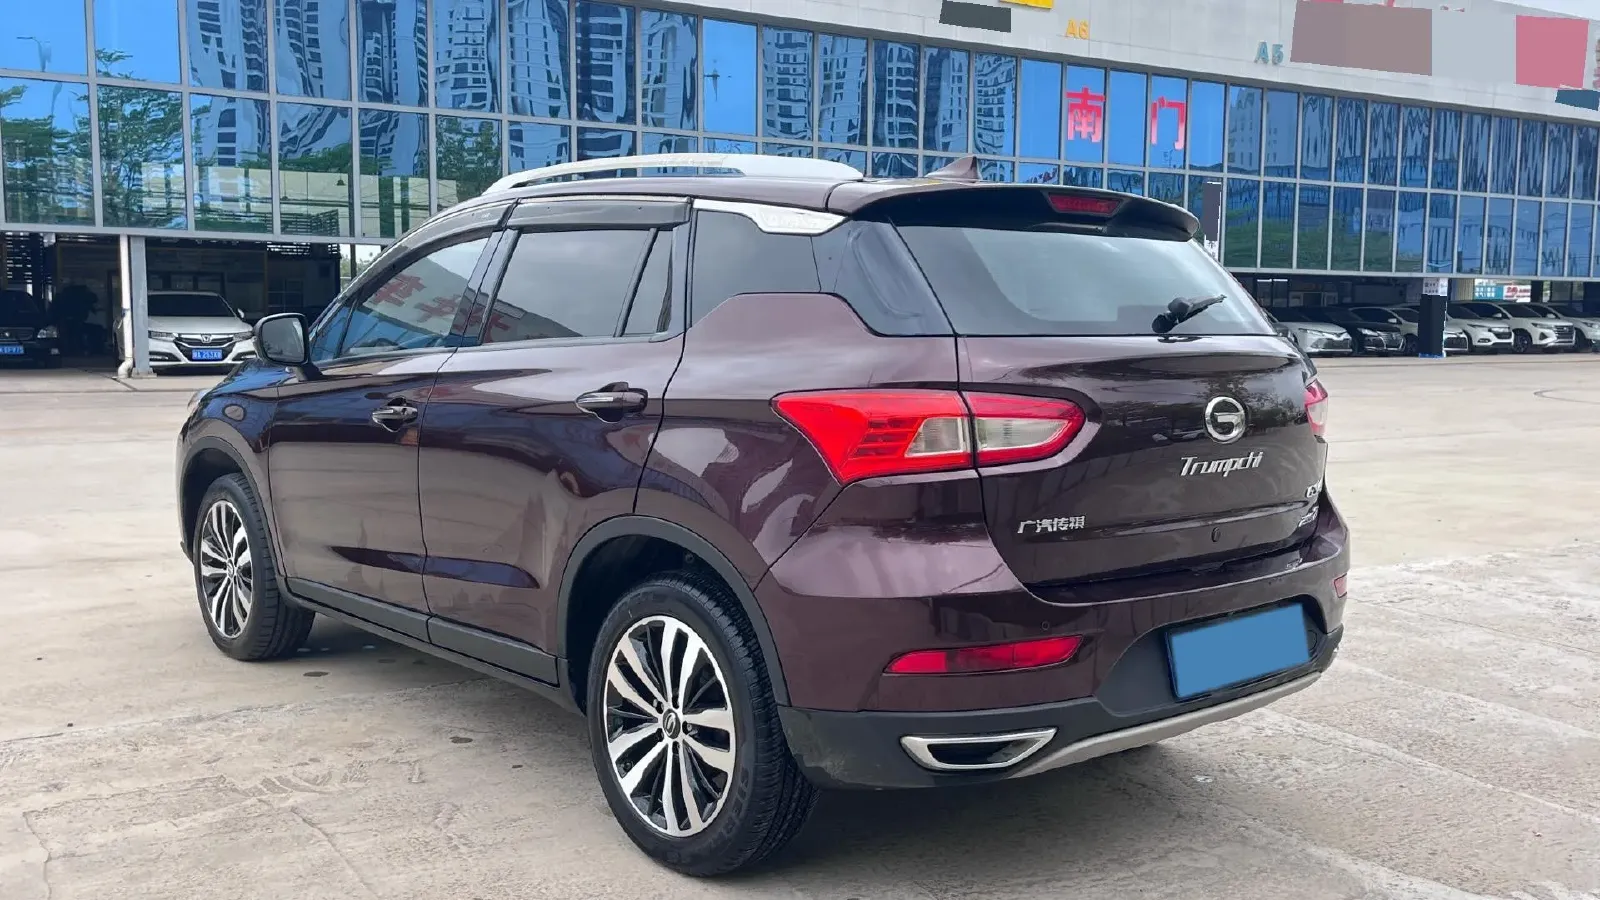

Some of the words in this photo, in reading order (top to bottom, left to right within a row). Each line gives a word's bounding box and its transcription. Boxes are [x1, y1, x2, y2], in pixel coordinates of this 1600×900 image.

[1065, 18, 1089, 40] A6
[1254, 41, 1284, 66] A5
[1066, 87, 1186, 150] 南门
[1181, 452, 1263, 477] Trumpchi
[1017, 516, 1086, 534] 广汽传祺
